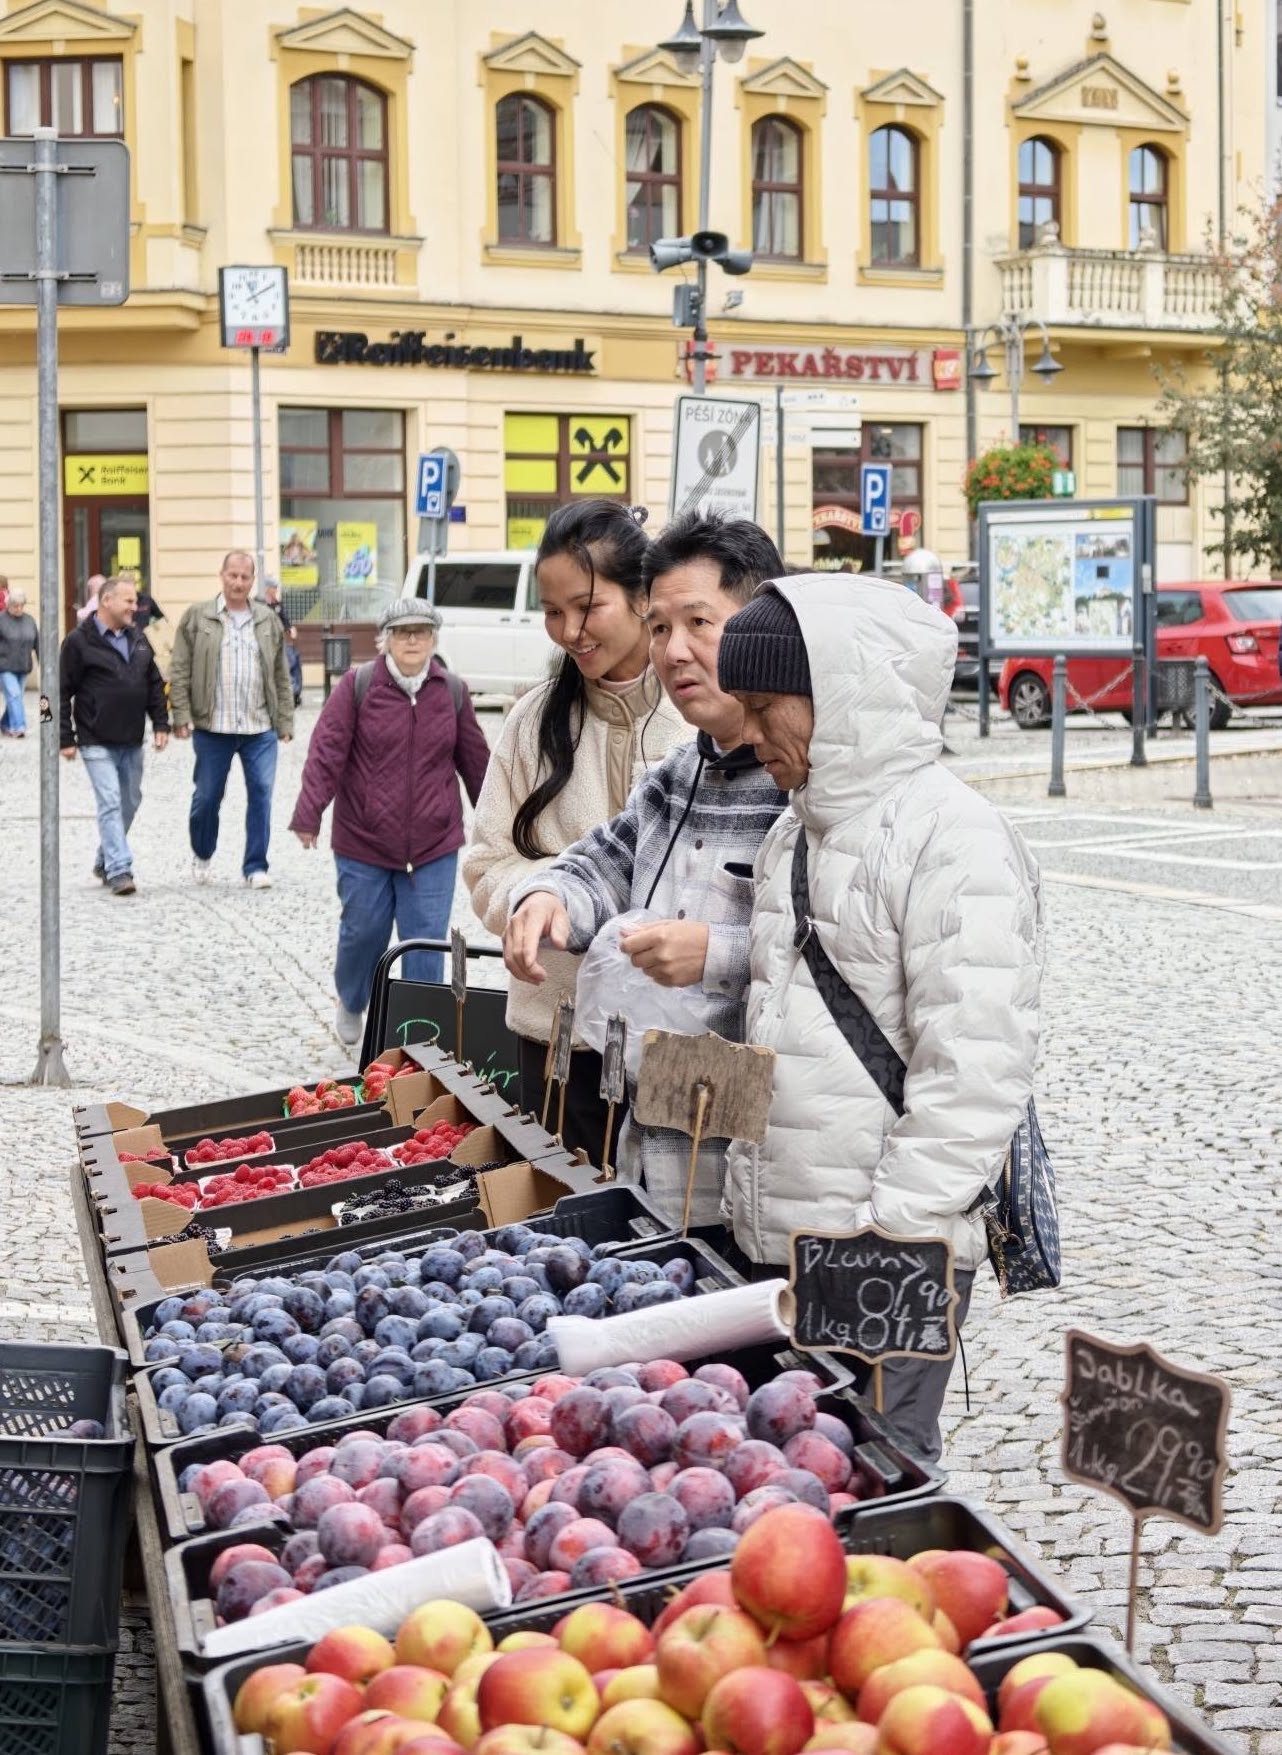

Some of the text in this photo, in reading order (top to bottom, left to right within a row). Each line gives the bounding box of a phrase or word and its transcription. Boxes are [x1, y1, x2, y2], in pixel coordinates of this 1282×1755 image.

[336, 331, 596, 370] Raiffeisenbank
[730, 347, 920, 381] PEKAŘSTVÍ
[422, 461, 440, 497] P
[866, 473, 884, 513] P
